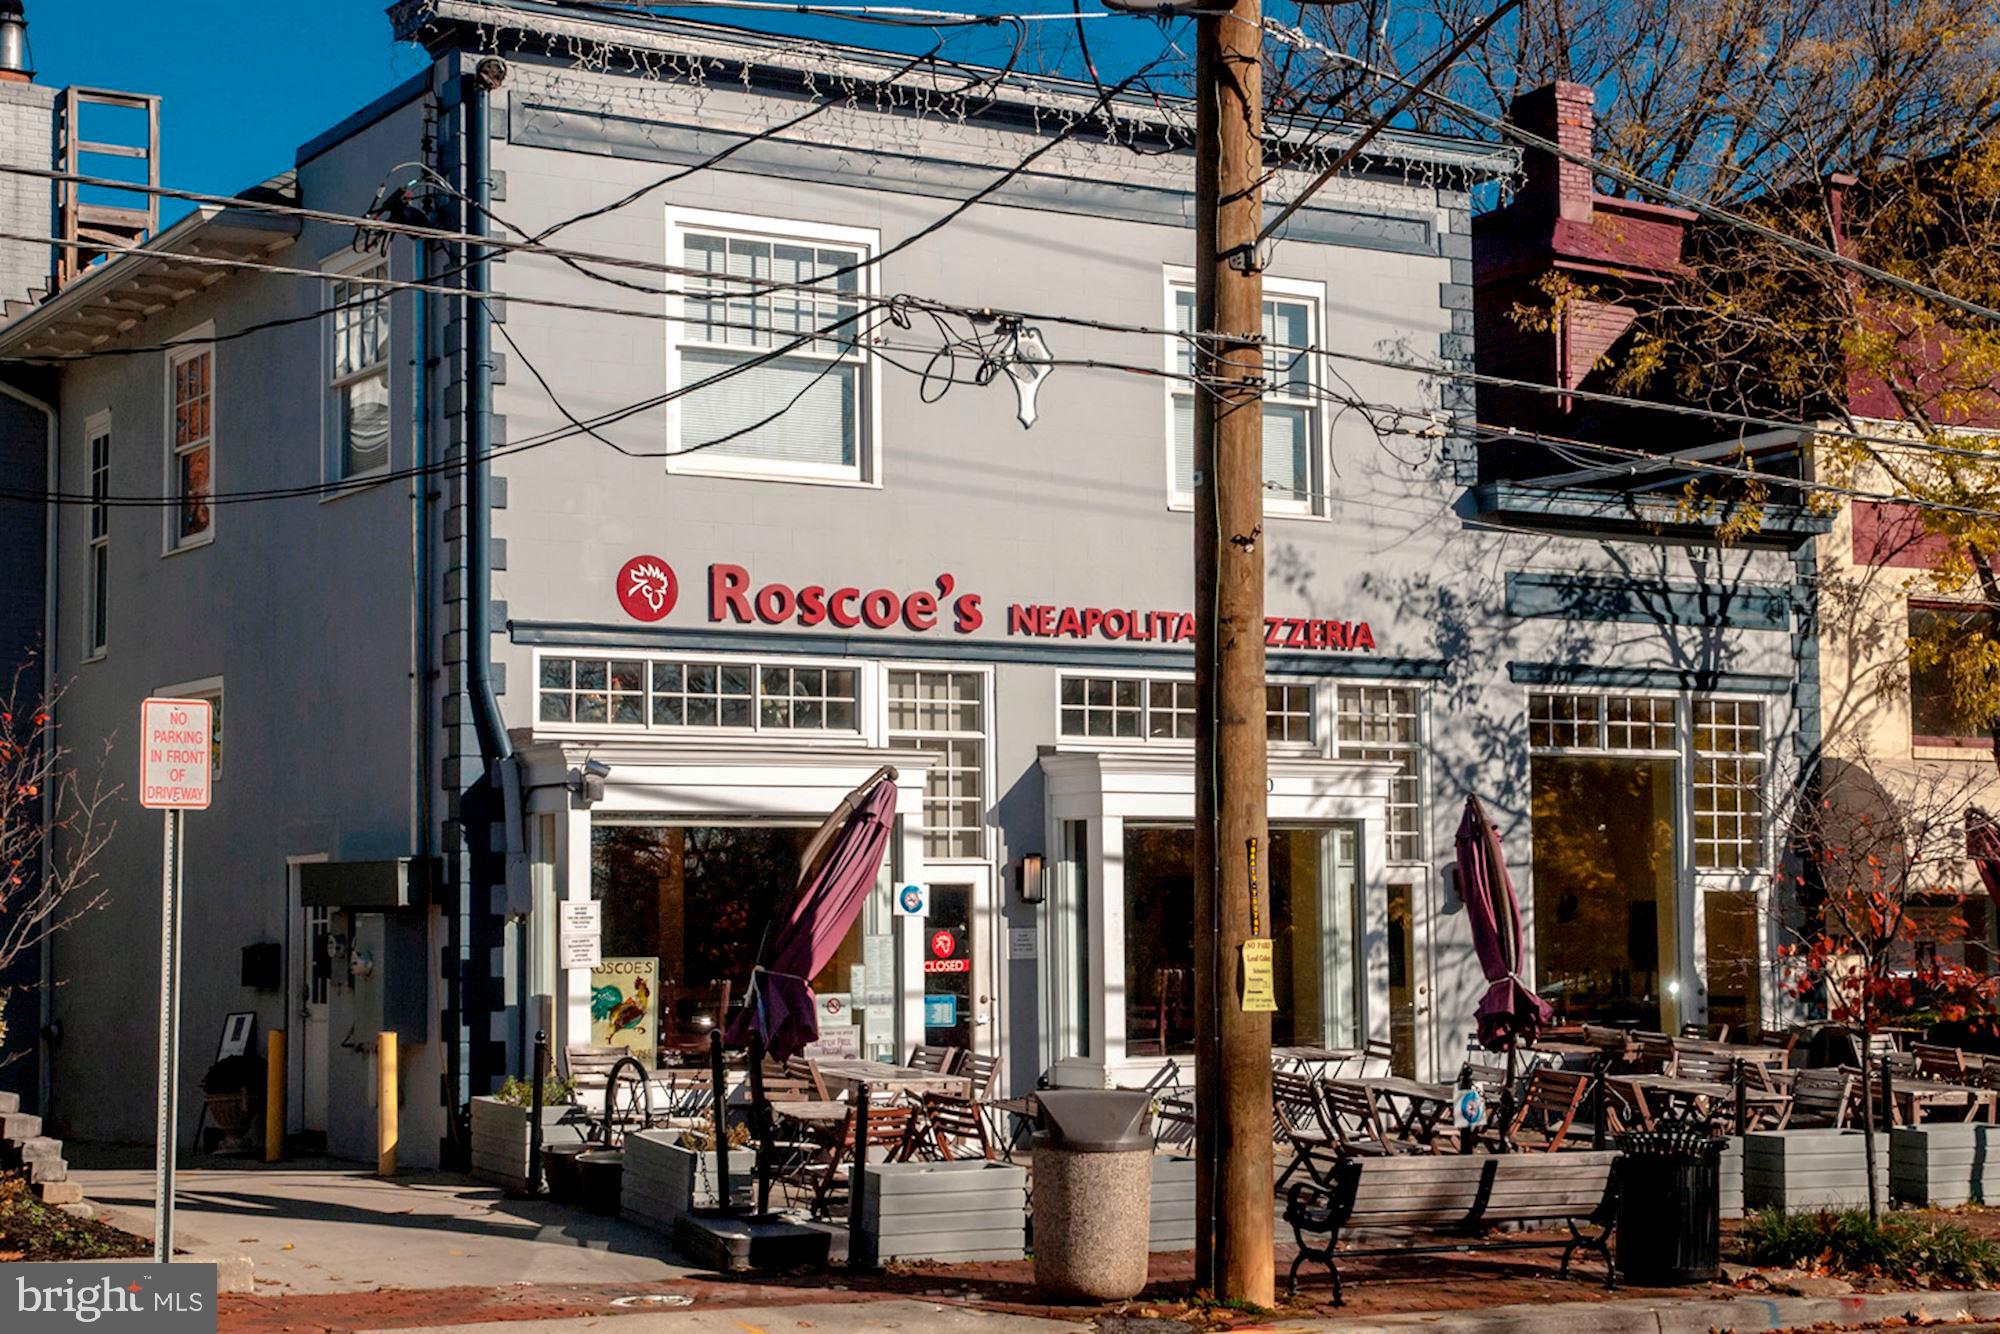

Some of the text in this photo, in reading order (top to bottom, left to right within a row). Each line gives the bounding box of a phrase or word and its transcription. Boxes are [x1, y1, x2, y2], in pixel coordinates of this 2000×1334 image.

[708, 563, 1376, 652] Roscoe's NEAPOLITA ZZERIA
[170, 712, 187, 725] NO
[154, 730, 203, 744] PARKING
[150, 750, 205, 763] IN FRONT
[169, 768, 186, 782] OF
[147, 786, 203, 800] DRIVEWAY
[924, 960, 963, 973] CLOSED
